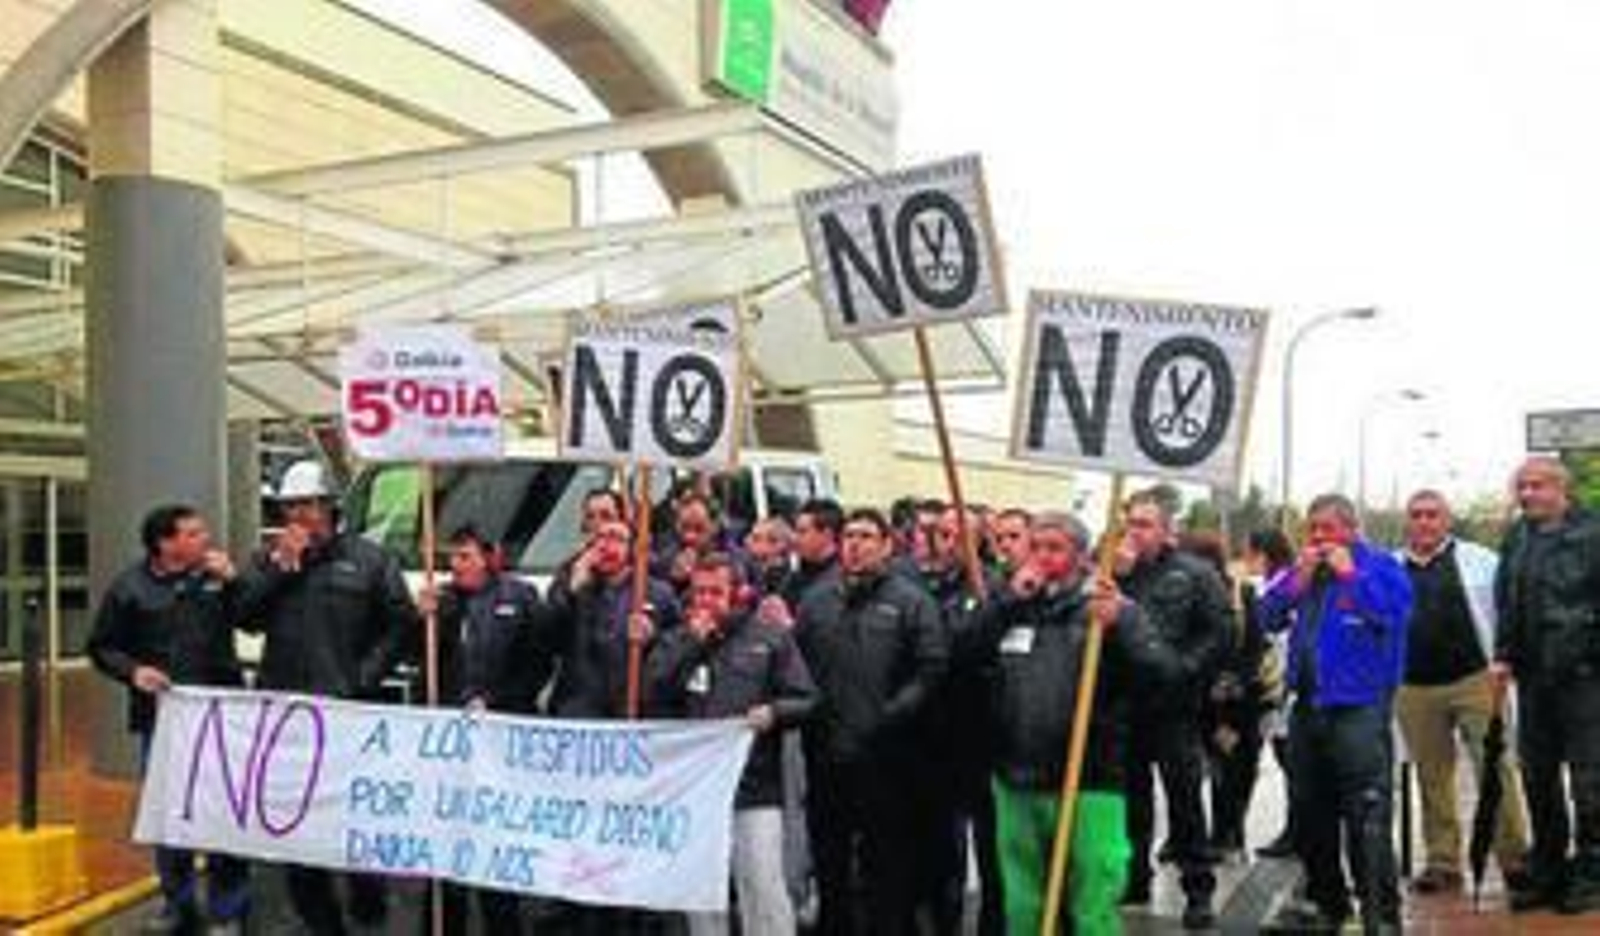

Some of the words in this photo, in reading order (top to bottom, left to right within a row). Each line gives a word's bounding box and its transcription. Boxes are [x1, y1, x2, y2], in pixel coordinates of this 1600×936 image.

[819, 189, 979, 324] NO
[567, 345, 727, 458] NO
[1026, 322, 1235, 467] NO
[181, 698, 325, 837] NO
[360, 718, 390, 757] A
[416, 717, 480, 763] LOS
[503, 723, 653, 778] DESPIDOS
[350, 775, 415, 817] POR
[597, 802, 692, 852] DIGNO
